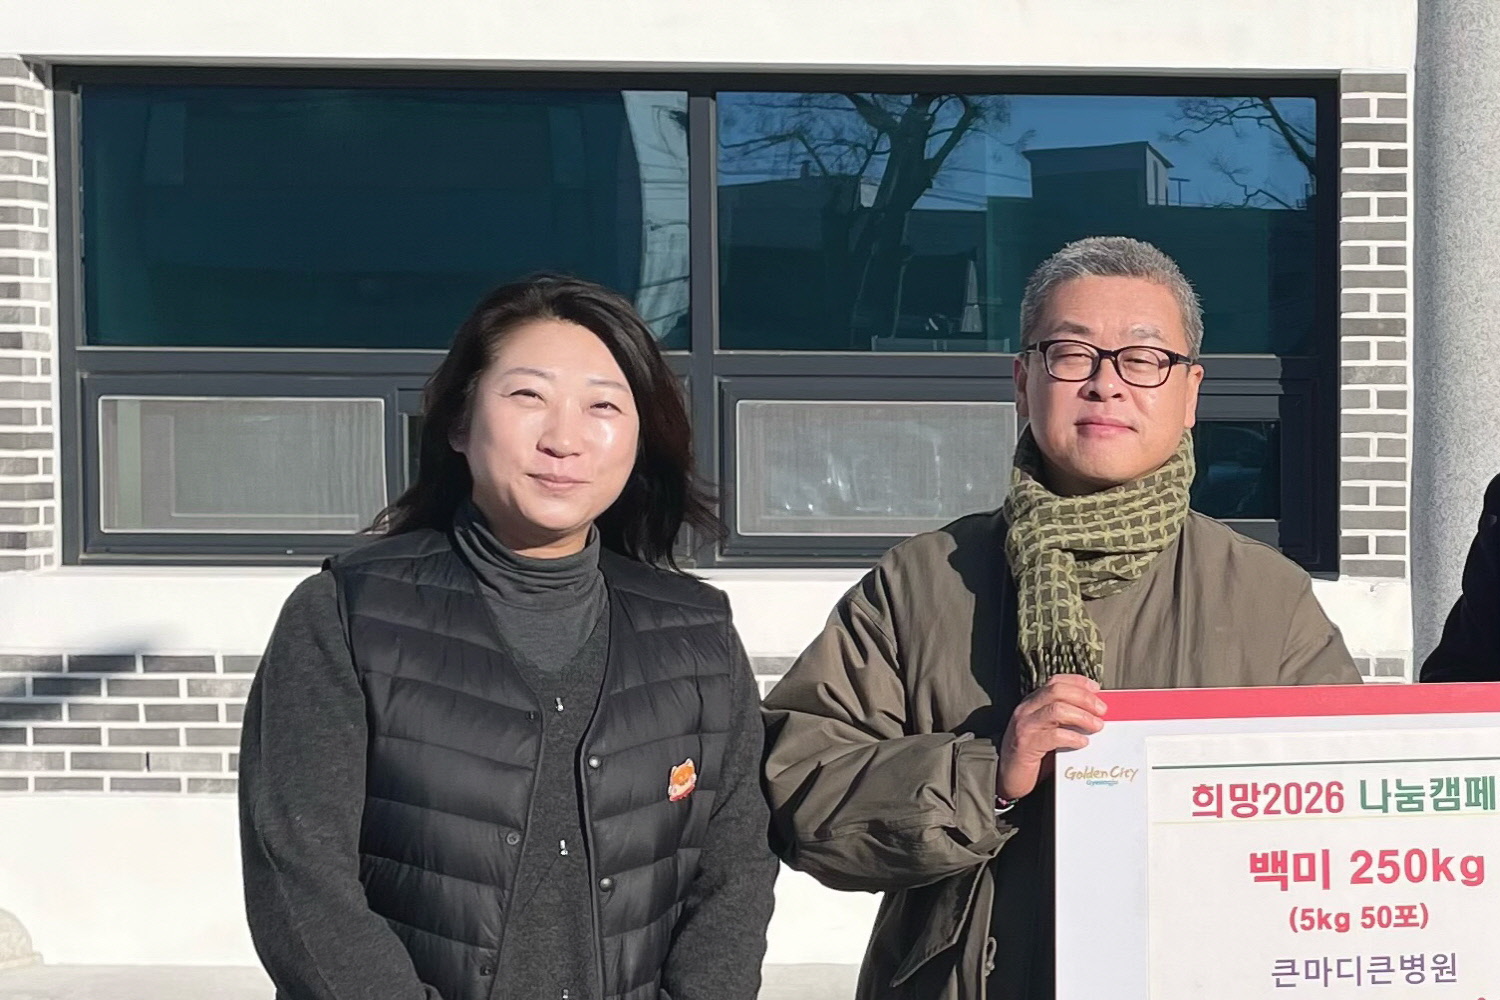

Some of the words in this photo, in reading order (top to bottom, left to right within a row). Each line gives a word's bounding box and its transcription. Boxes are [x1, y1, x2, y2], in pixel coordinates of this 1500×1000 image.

[1064, 765, 1109, 780] Golden
[1191, 781, 1345, 818] 희망2026
[1248, 849, 1331, 890] 백미
[1349, 848, 1486, 887] 250kg
[1288, 907, 1351, 934] (5kg
[1360, 903, 1430, 932] 50포)
[1270, 952, 1459, 989] 큰마디큰병원
